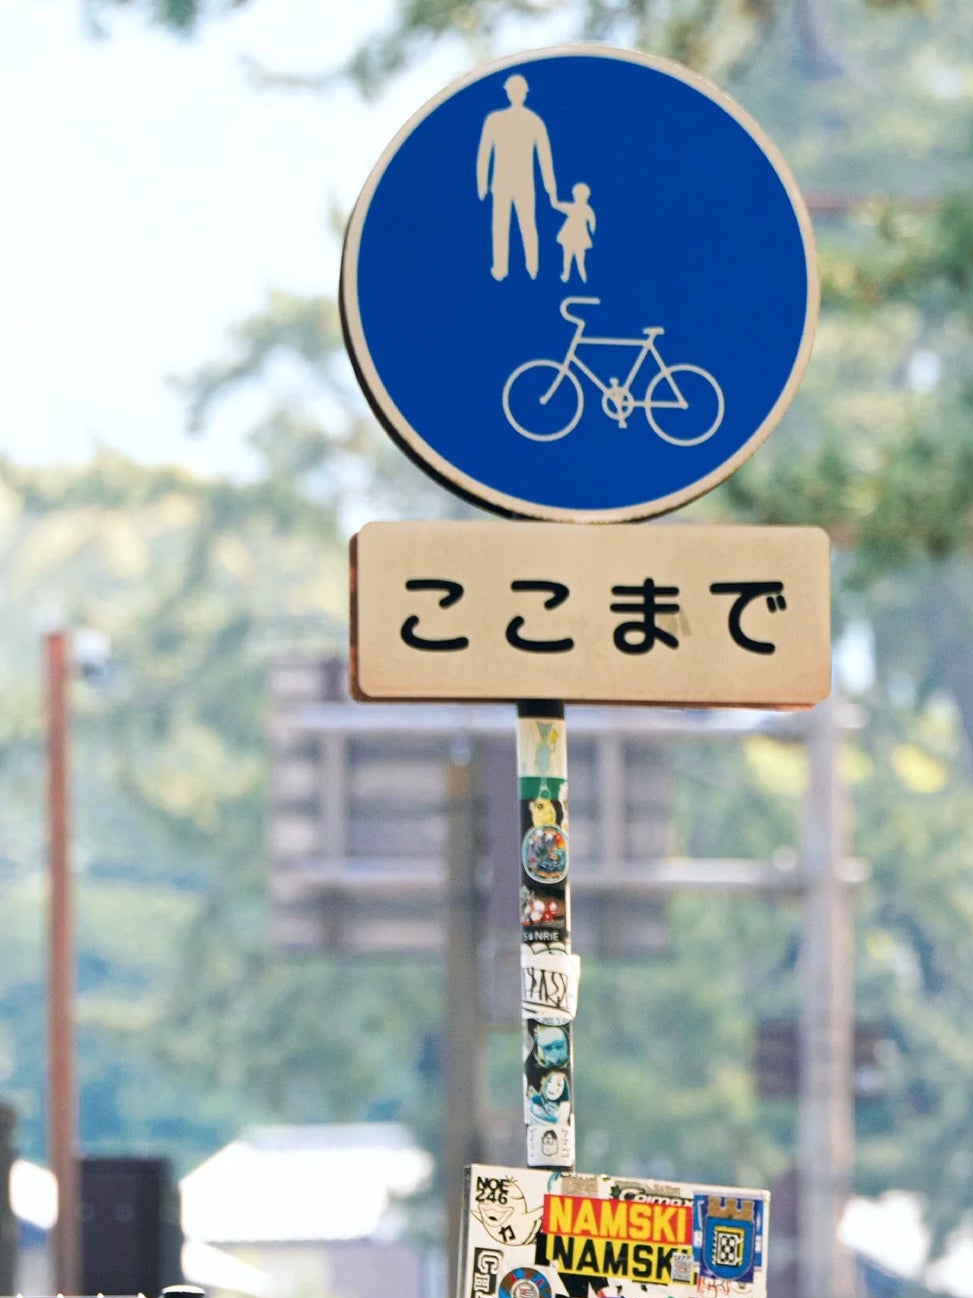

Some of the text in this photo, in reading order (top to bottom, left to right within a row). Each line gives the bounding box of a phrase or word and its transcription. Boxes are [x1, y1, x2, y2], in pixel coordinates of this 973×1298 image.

[400, 577, 787, 655] ここまで
[548, 1196, 687, 1244] NAMSKI
[552, 1235, 690, 1281] NAMSK
